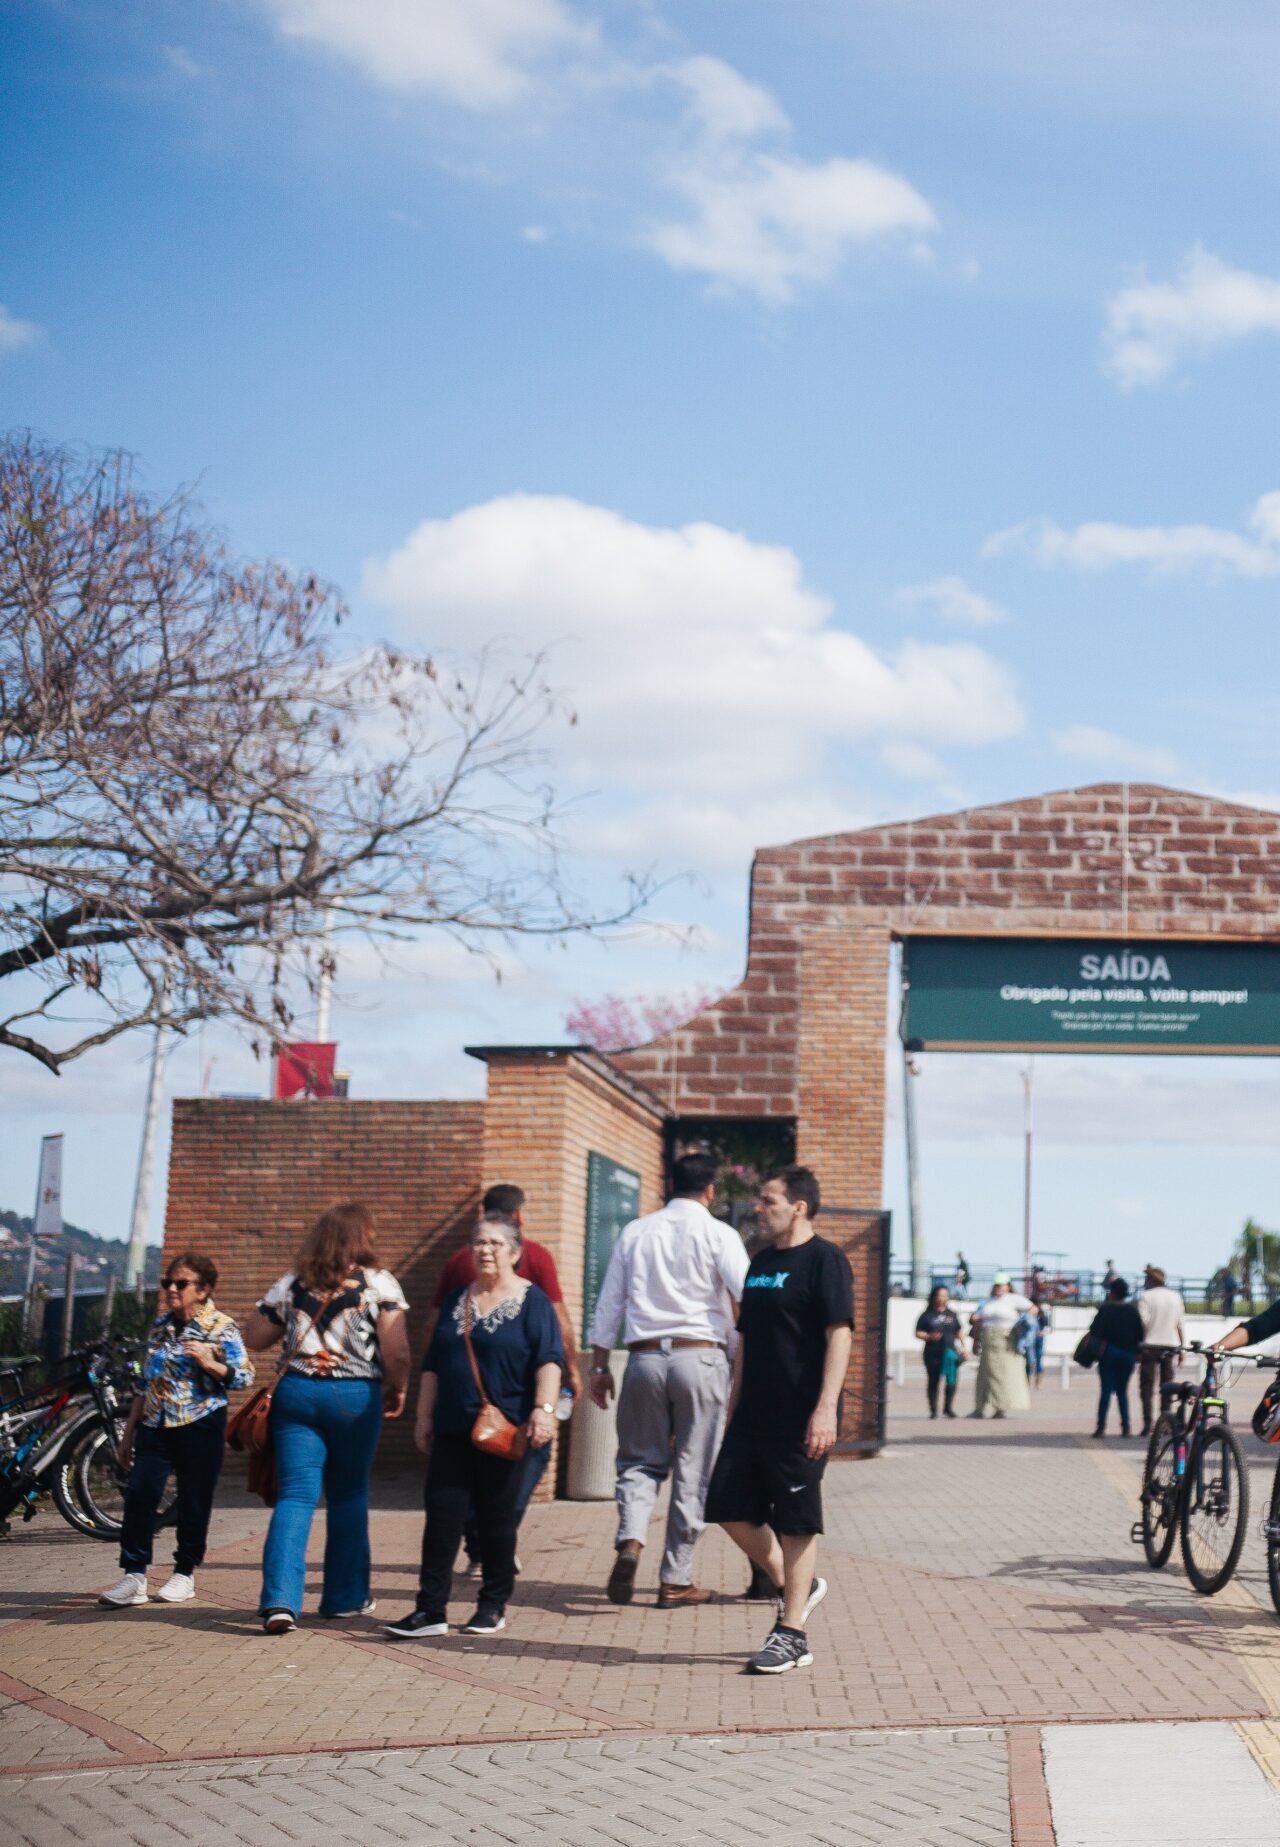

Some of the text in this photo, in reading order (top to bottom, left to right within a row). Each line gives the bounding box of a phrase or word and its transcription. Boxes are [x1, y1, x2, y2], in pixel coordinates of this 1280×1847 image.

[1080, 949, 1171, 981] SAÍDA
[1000, 984, 1248, 1006] Obrigado pela visita. Volte sempre!
